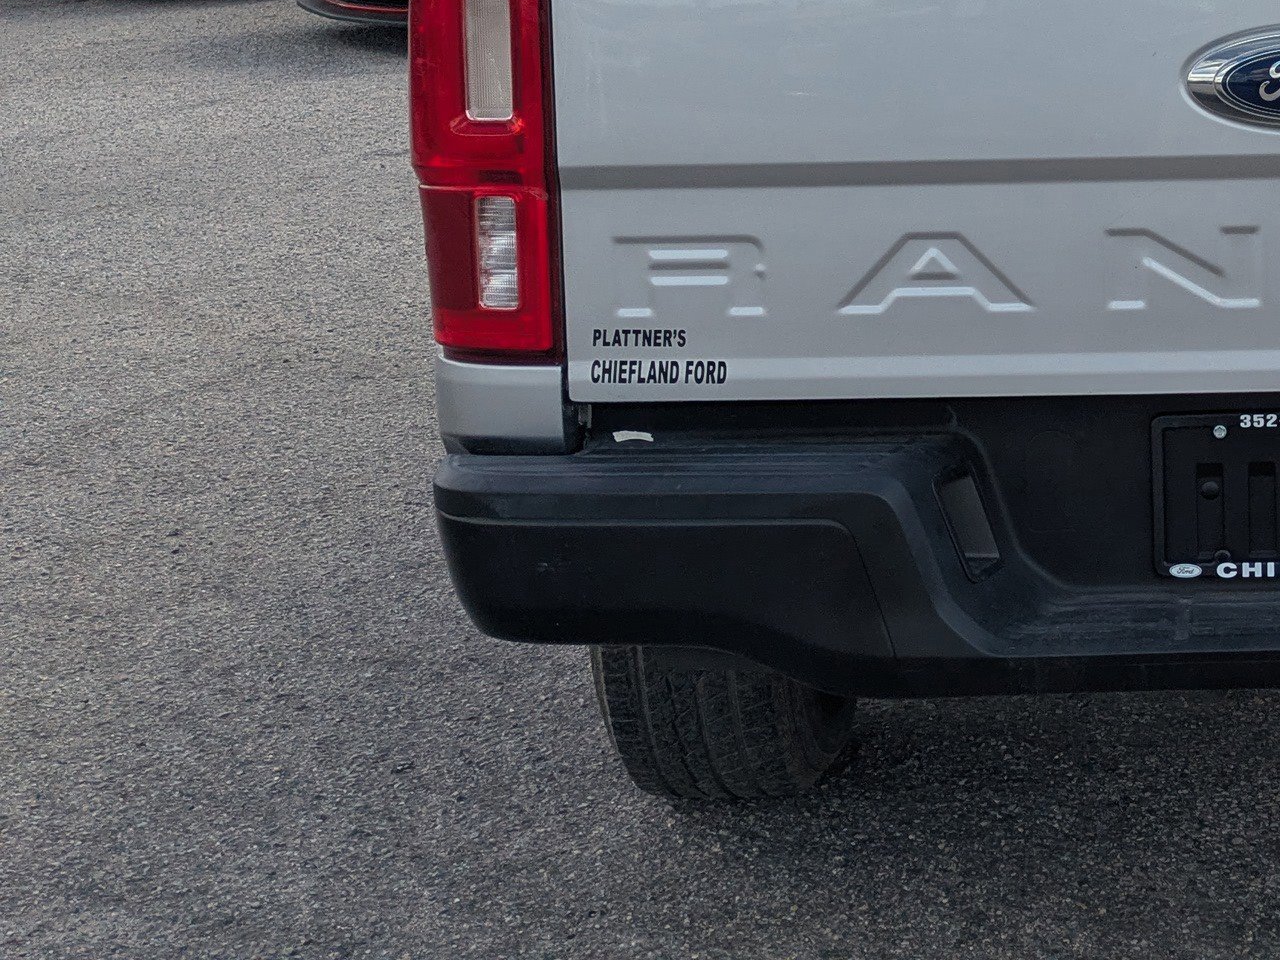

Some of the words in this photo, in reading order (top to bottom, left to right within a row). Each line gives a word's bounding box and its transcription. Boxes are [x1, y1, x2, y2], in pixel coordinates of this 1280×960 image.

[592, 329, 687, 347] PLATTNER'S
[591, 360, 680, 384] CHIEFLAND
[684, 360, 728, 384] FORD
